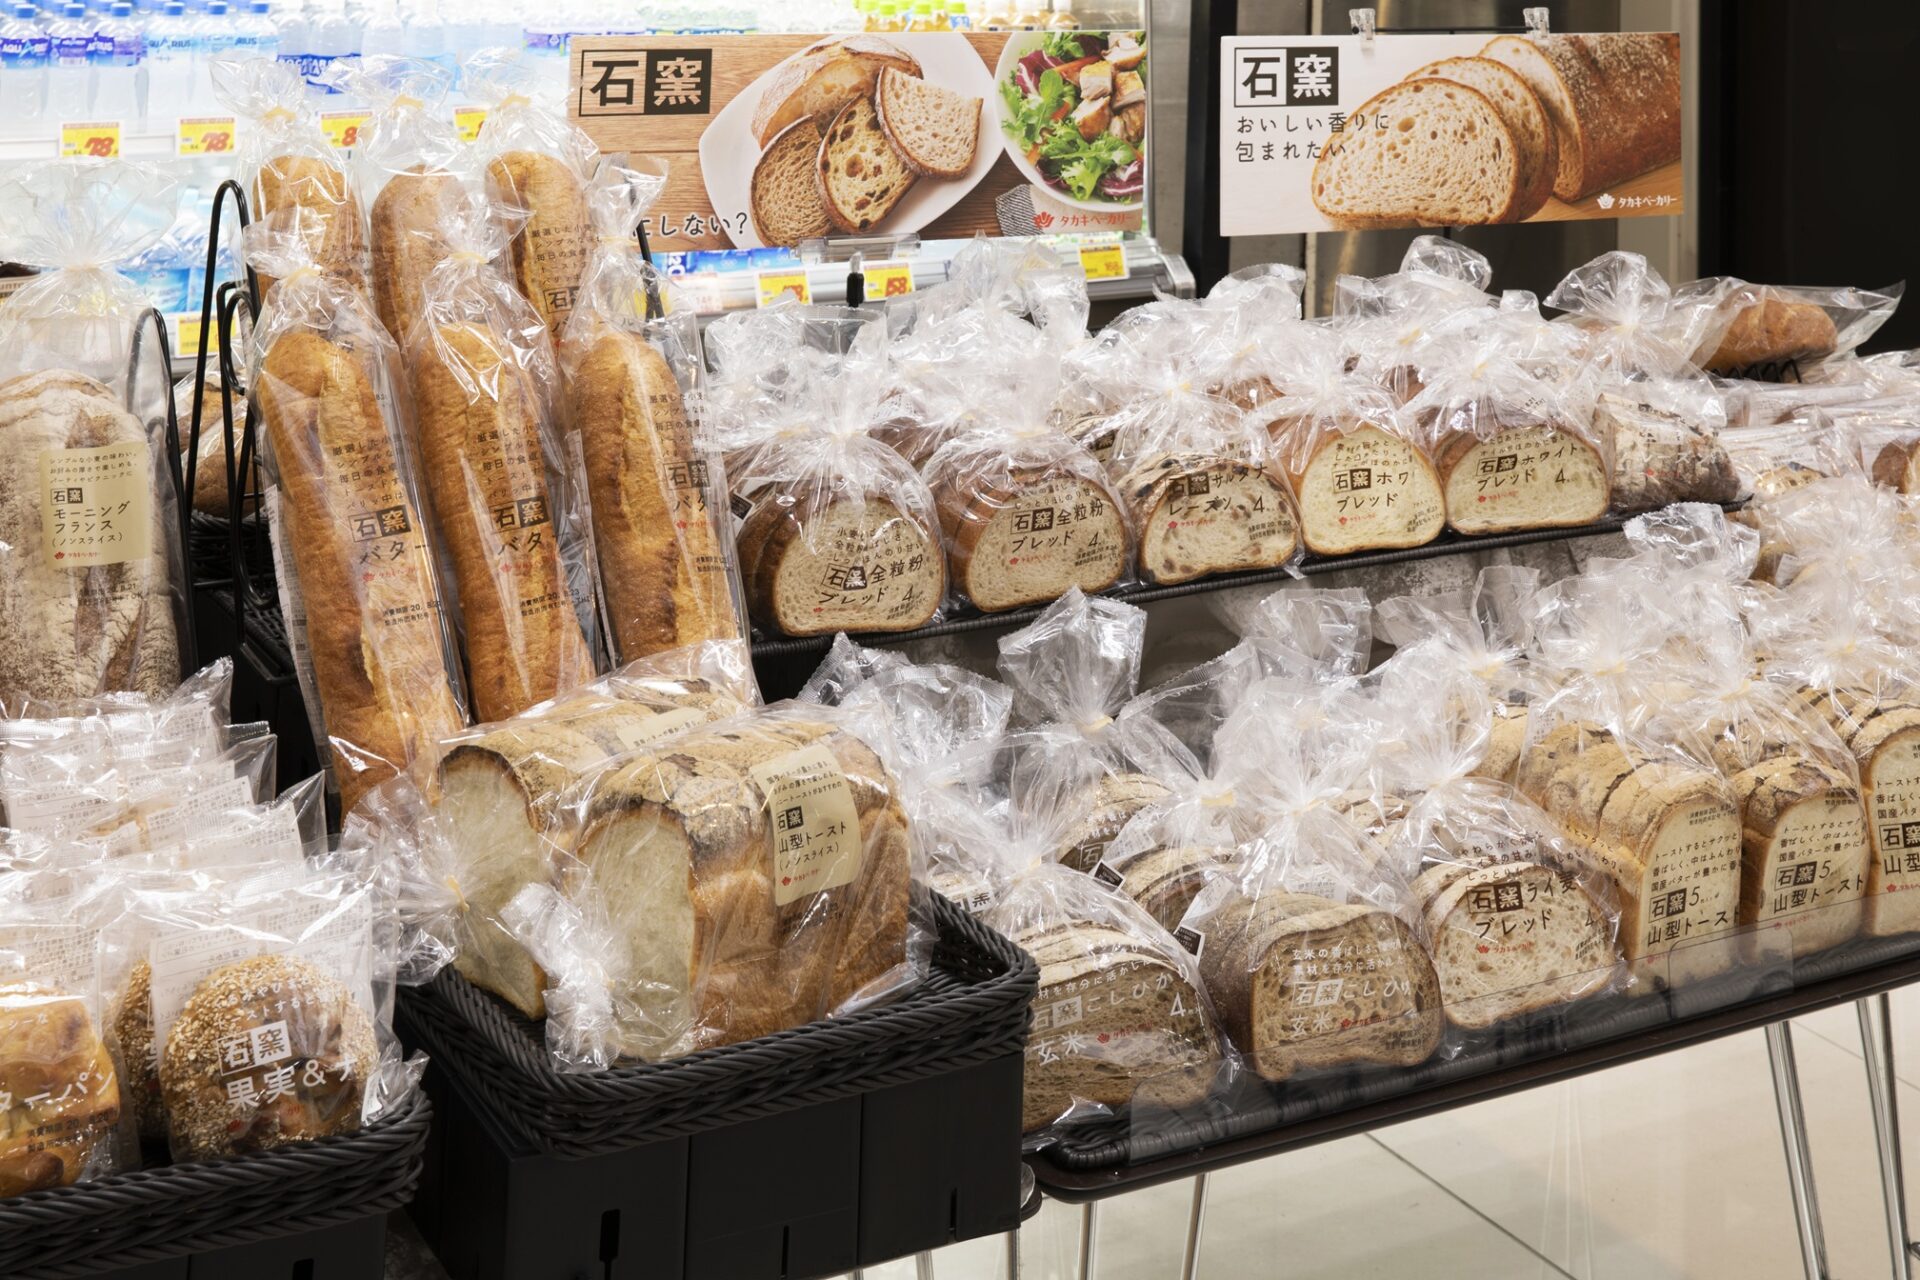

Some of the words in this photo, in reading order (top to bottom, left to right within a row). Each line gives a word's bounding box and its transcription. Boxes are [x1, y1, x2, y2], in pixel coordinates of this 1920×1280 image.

[585, 53, 706, 110] 石窯
[1238, 51, 1336, 102] 石窯
[1237, 112, 1390, 134] おいしい香りに
[201, 131, 231, 153] 78
[1235, 140, 1346, 163] 包まれたい
[1618, 194, 1679, 209] タカキベーカリー
[1060, 212, 1134, 227] タカキベーカリー
[1478, 455, 1518, 475] 石窯
[1521, 442, 1578, 465] ホワイト
[665, 462, 709, 488] 石窯
[1168, 473, 1211, 497] 石窯
[1333, 468, 1370, 491] 石窯
[1477, 469, 1535, 493] ブレッド
[1554, 467, 1567, 484] 4
[52, 488, 82, 504] 石窯
[1169, 496, 1232, 516] レーズン
[1253, 496, 1266, 513] 4
[1337, 493, 1399, 513] ブレッド
[53, 500, 131, 519] モーニング
[492, 499, 545, 530] 石窯
[1011, 509, 1053, 533] 石窯
[1056, 498, 1104, 526] 全粒粉
[54, 519, 113, 535] フランス
[353, 510, 409, 539] 石窯
[1012, 529, 1076, 553] ブレッド
[1088, 531, 1100, 547] 4
[826, 564, 867, 590] 石窯
[870, 553, 924, 585] 全粒粉
[818, 585, 889, 606] ブレッド
[901, 584, 914, 603] 4
[775, 807, 803, 832] 石窯
[778, 819, 848, 854] 山型トースト
[1881, 824, 1920, 848] 石窯
[1776, 862, 1816, 888] 石窯
[1818, 863, 1831, 880] 5
[1884, 852, 1920, 876] 山型
[1469, 885, 1522, 910] 石窯
[1526, 874, 1578, 903] ライ麦
[1772, 873, 1865, 915] 山型トースト
[1650, 889, 1686, 920] 石窯
[1688, 885, 1701, 907] 5
[1475, 908, 1553, 939] ブレッド
[1646, 903, 1741, 948] 山型トースト
[1033, 996, 1082, 1032] 石窯
[1086, 963, 1191, 1015] こしひかり
[1169, 991, 1186, 1018] 4
[1294, 980, 1342, 1007] 石窯
[1289, 1010, 1330, 1037] 玄米
[220, 1024, 288, 1071] 石窯
[1032, 1029, 1088, 1067] 玄米
